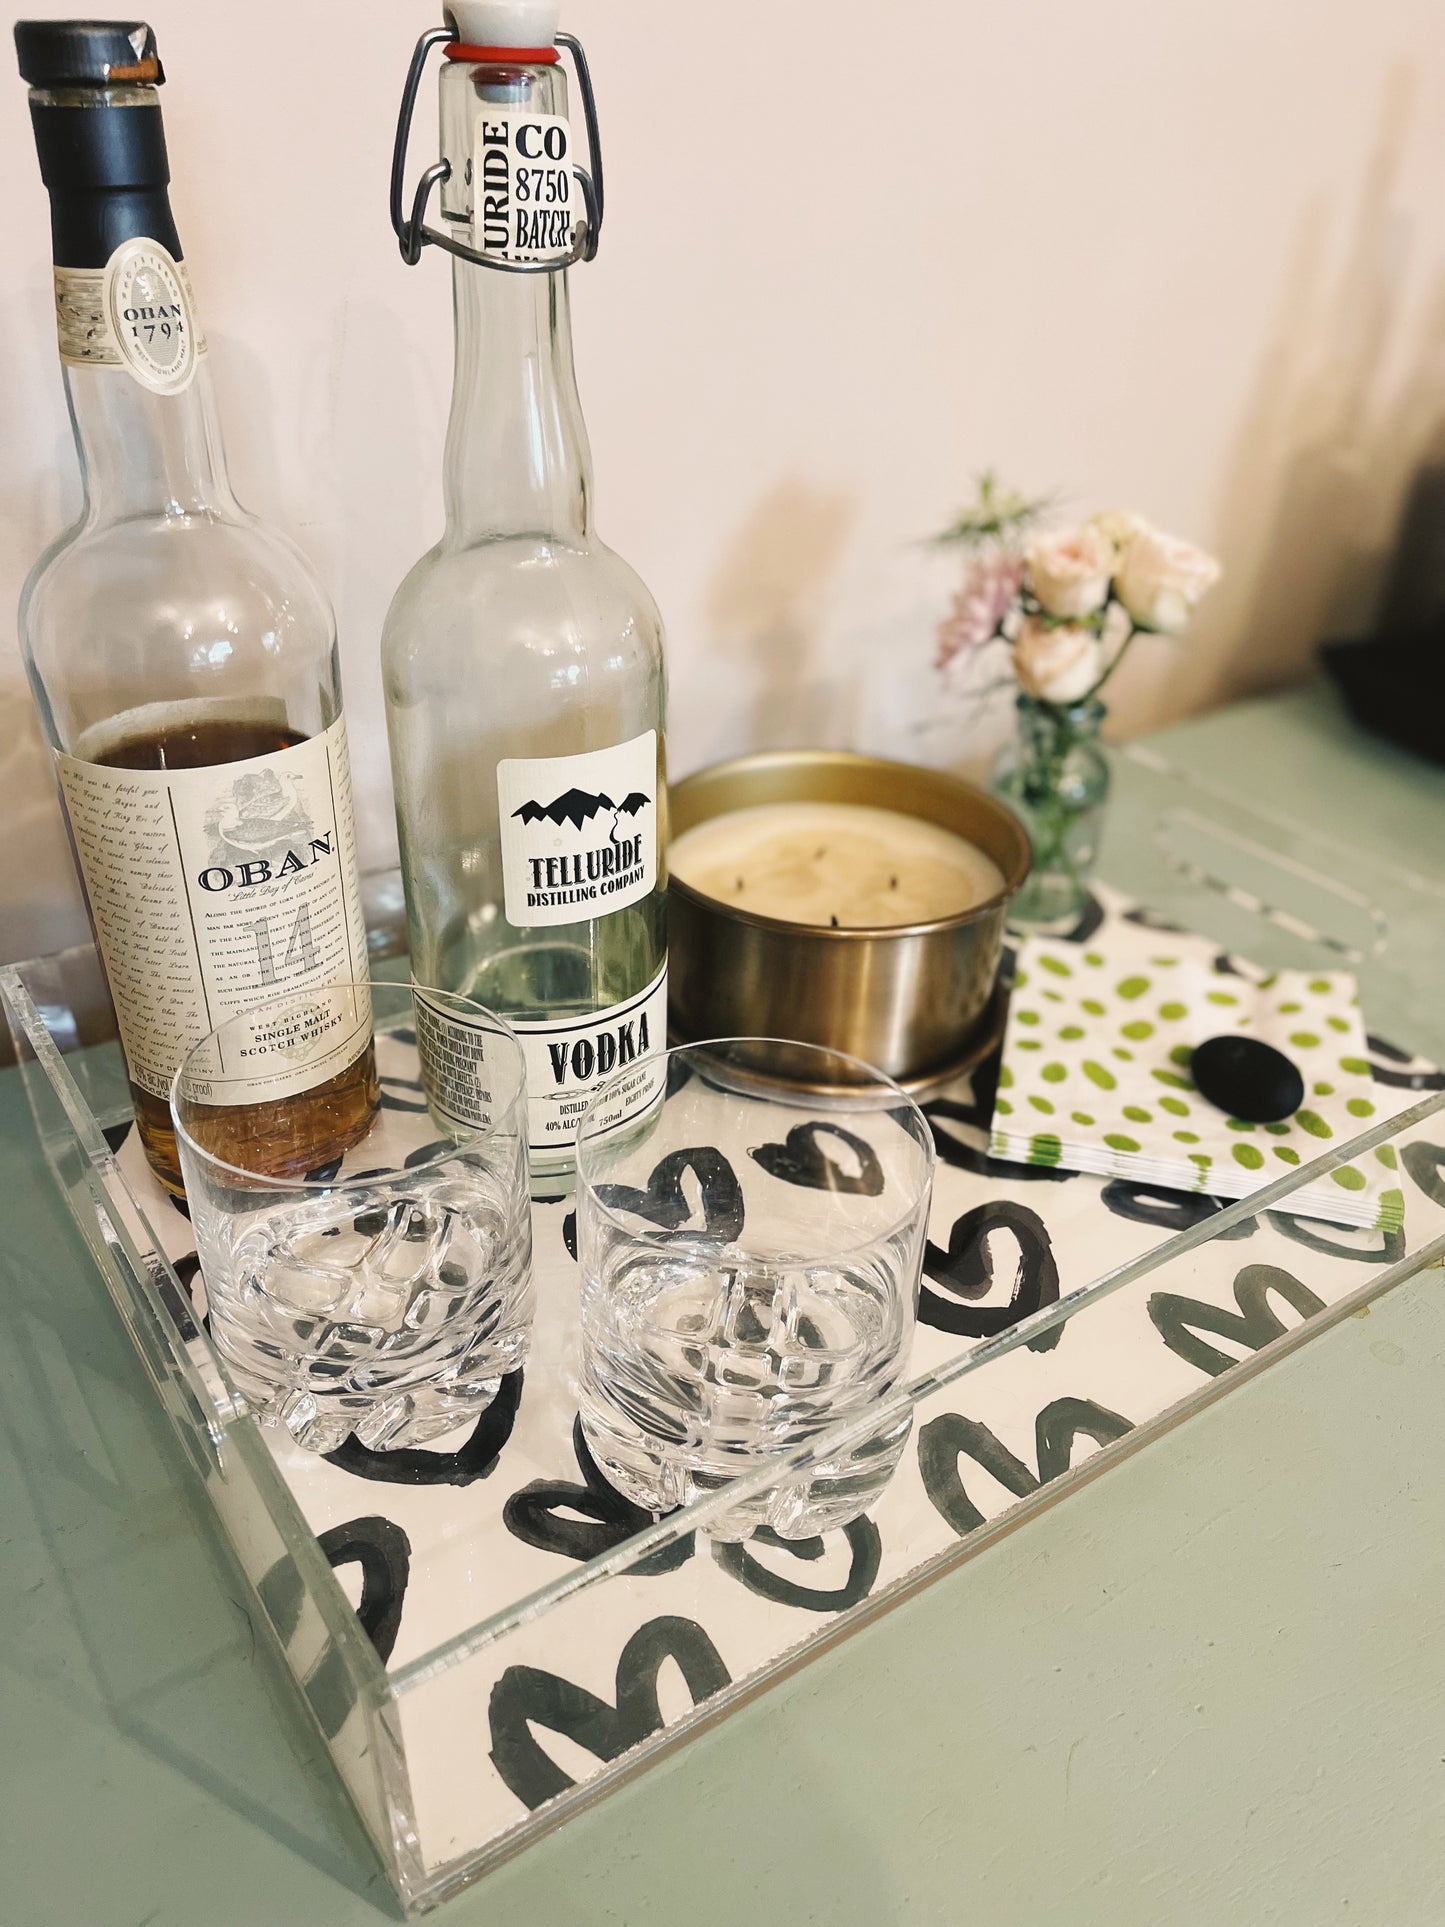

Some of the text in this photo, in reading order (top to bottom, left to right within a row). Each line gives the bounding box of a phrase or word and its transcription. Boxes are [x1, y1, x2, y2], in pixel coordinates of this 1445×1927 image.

[516, 125, 566, 160] CO
[483, 122, 509, 260] URIDE
[516, 168, 568, 203] 8750
[516, 209, 570, 249] BATCH
[124, 305, 181, 321] OBAN
[131, 321, 183, 344] 1794
[529, 834, 642, 889] TELLURIDE
[259, 886, 279, 896] Bay
[282, 877, 294, 892] of
[527, 865, 644, 906] DISTILLING COMPANY
[280, 896, 293, 904] LORN
[227, 946, 258, 955] MAINLAND
[250, 999, 331, 1031] WEST HIGHLAND
[255, 1009, 331, 1043] SINGLE MALT
[241, 1013, 343, 1057] SCOTCH WHISKY
[468, 1032, 473, 1045] TO
[474, 1034, 483, 1048] THE
[547, 1011, 650, 1085] VODKA
[456, 1055, 477, 1074] PREGNANCY
[470, 1048, 484, 1062] DRINK
[560, 1101, 588, 1115] DISTILLED
[622, 1079, 636, 1094] SUGAR
[626, 1091, 642, 1106] EIGHTY
[545, 1122, 561, 1131] 40%
[599, 1109, 623, 1126] 750ml
